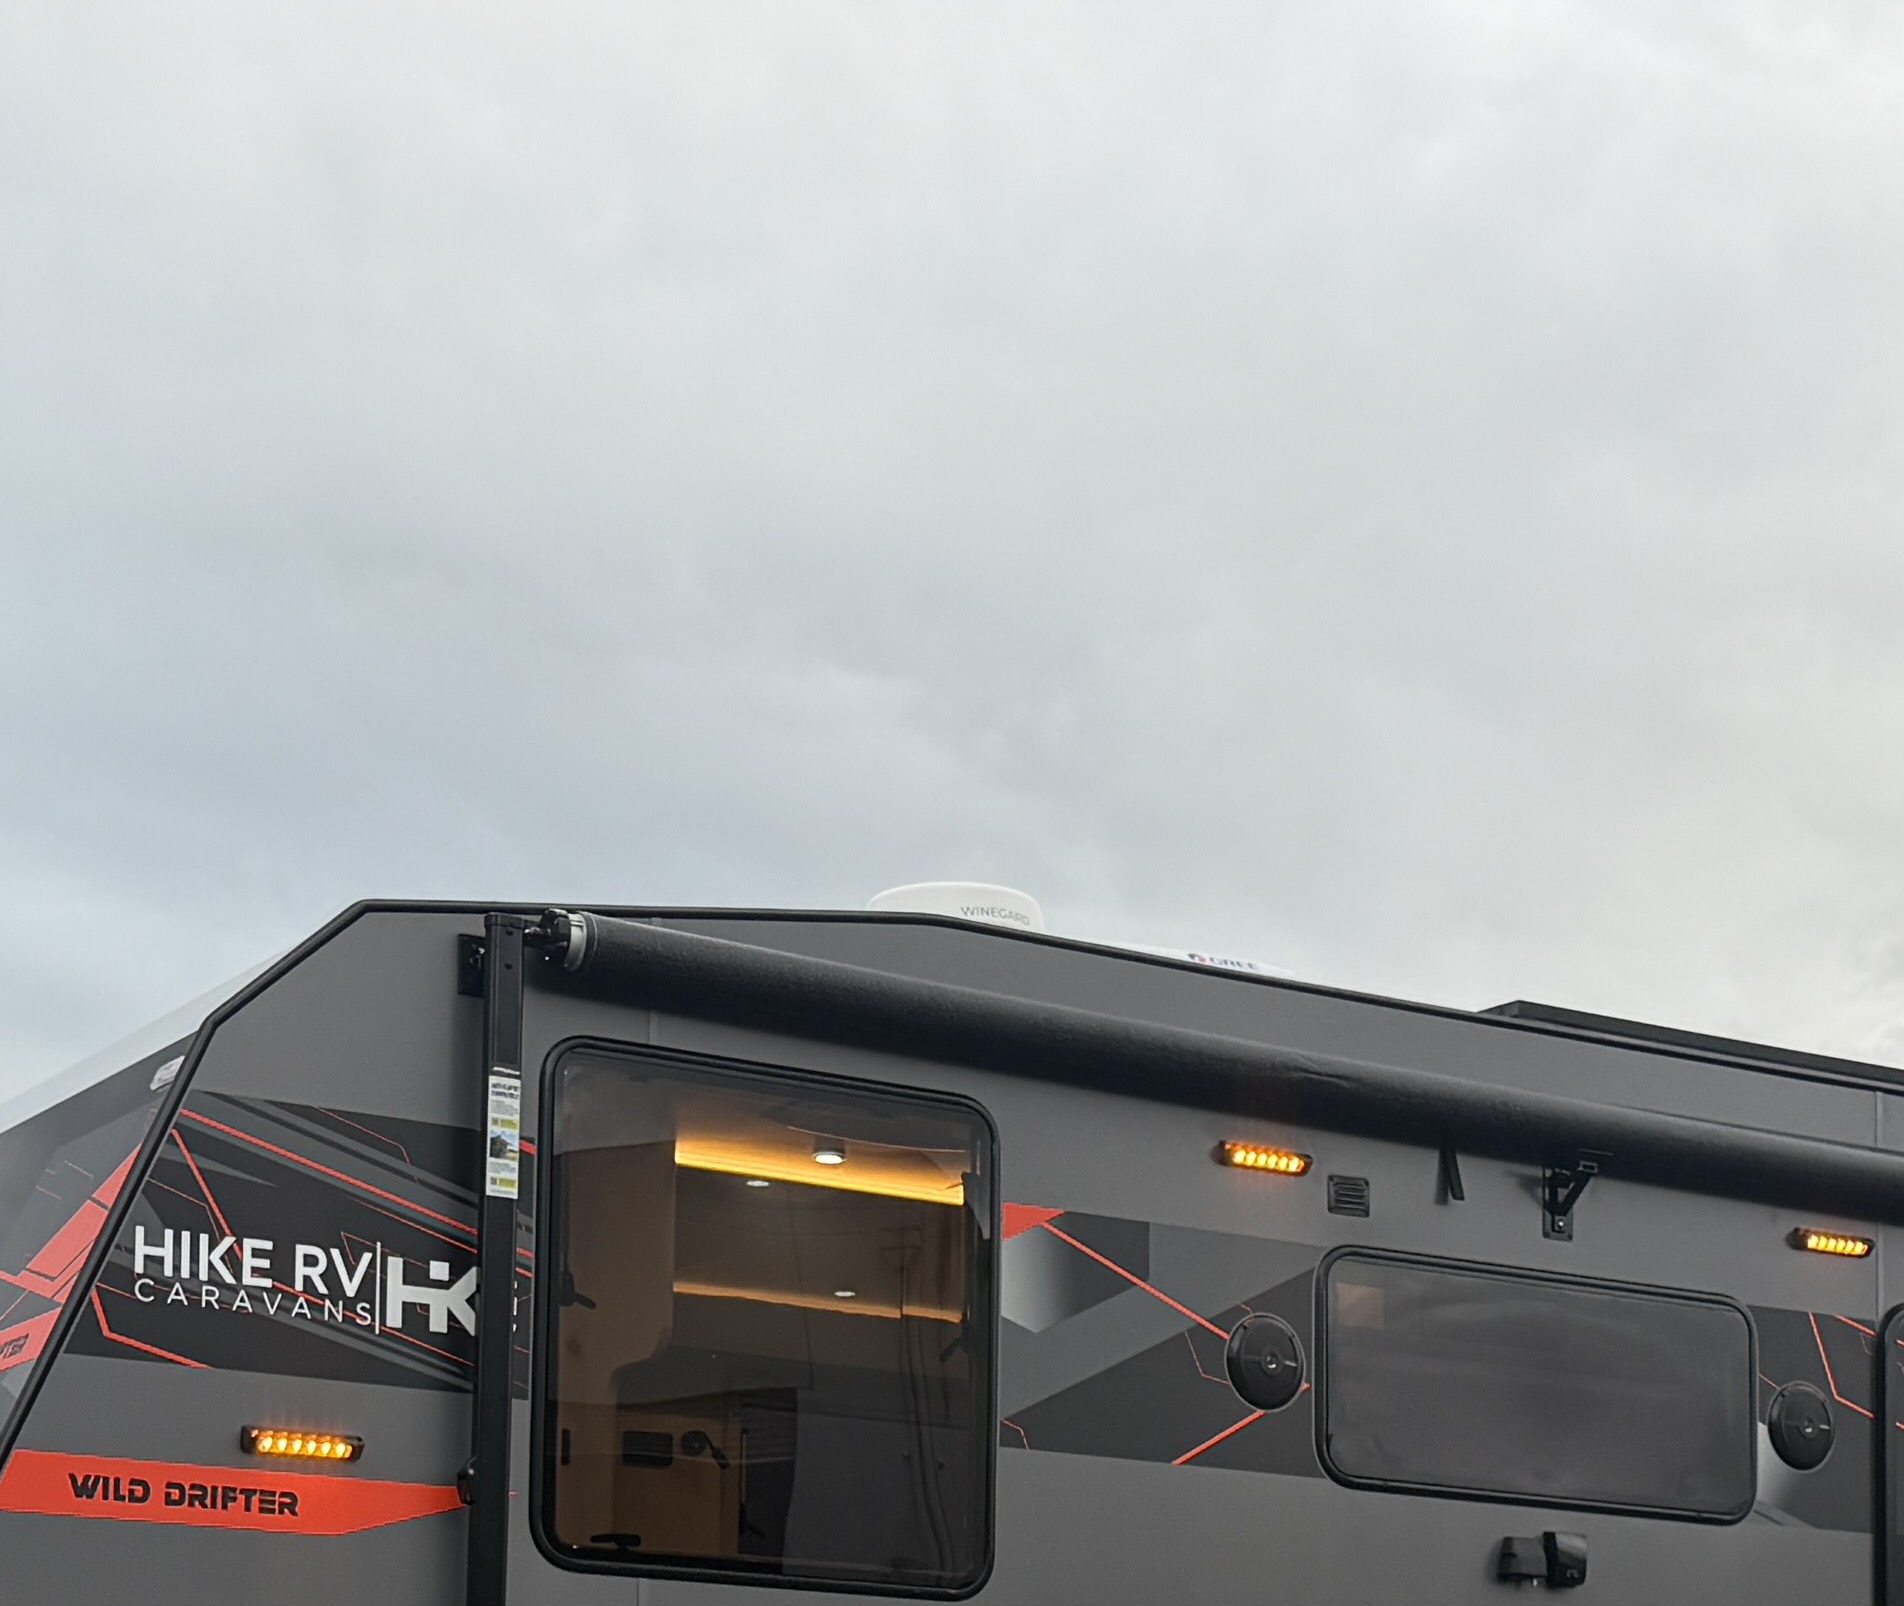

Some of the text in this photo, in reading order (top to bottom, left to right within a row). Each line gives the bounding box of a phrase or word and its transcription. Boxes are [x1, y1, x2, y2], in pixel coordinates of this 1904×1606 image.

[961, 905, 1031, 926] WINEGARD
[133, 1224, 274, 1288] HIKE
[294, 1243, 373, 1298] RV
[133, 1277, 372, 1326] CARAVANS
[68, 1472, 299, 1517] WILD DRIFTER
